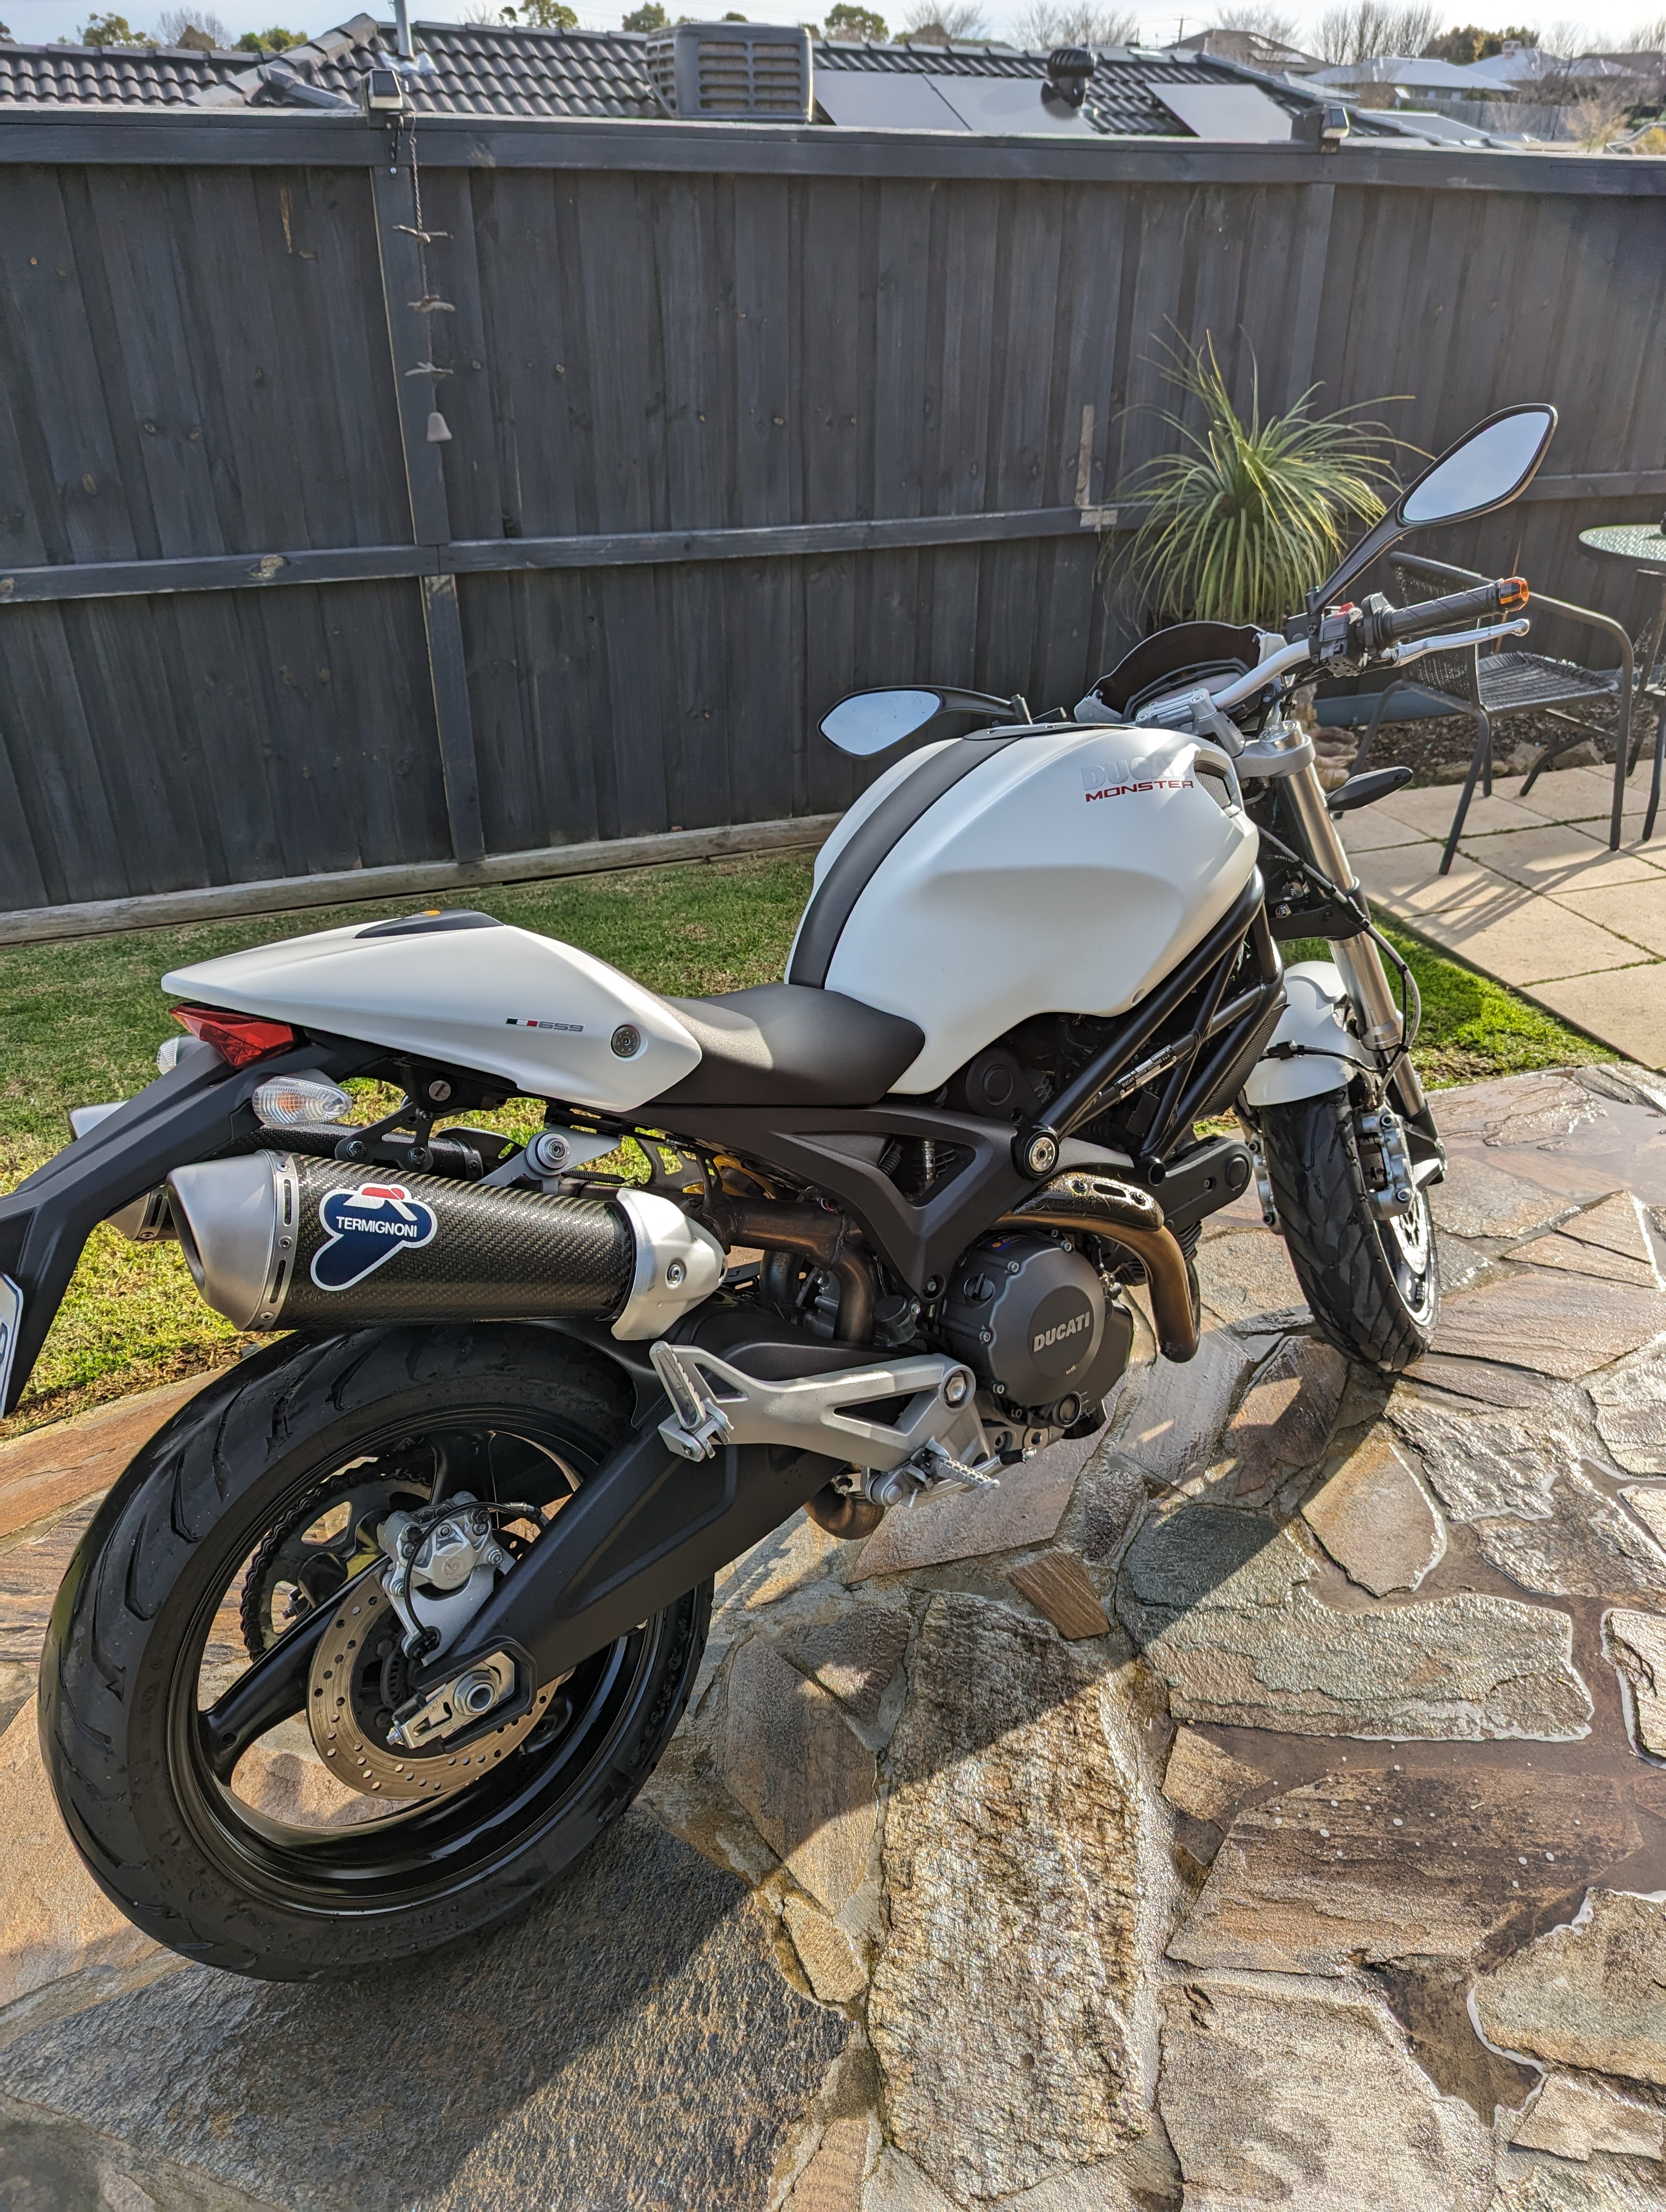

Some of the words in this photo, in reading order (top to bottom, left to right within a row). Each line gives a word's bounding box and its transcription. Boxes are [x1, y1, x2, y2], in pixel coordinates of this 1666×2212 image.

[1085, 780, 1194, 802] MONSTER
[539, 1021, 584, 1032] 659
[1122, 1077, 1135, 1088] DUCATI
[1135, 1068, 1148, 1079] MOTOR
[1146, 1058, 1163, 1071] HOLDING
[336, 1216, 417, 1238] TERMIGNONI
[1033, 1311, 1090, 1352] DUCATI
